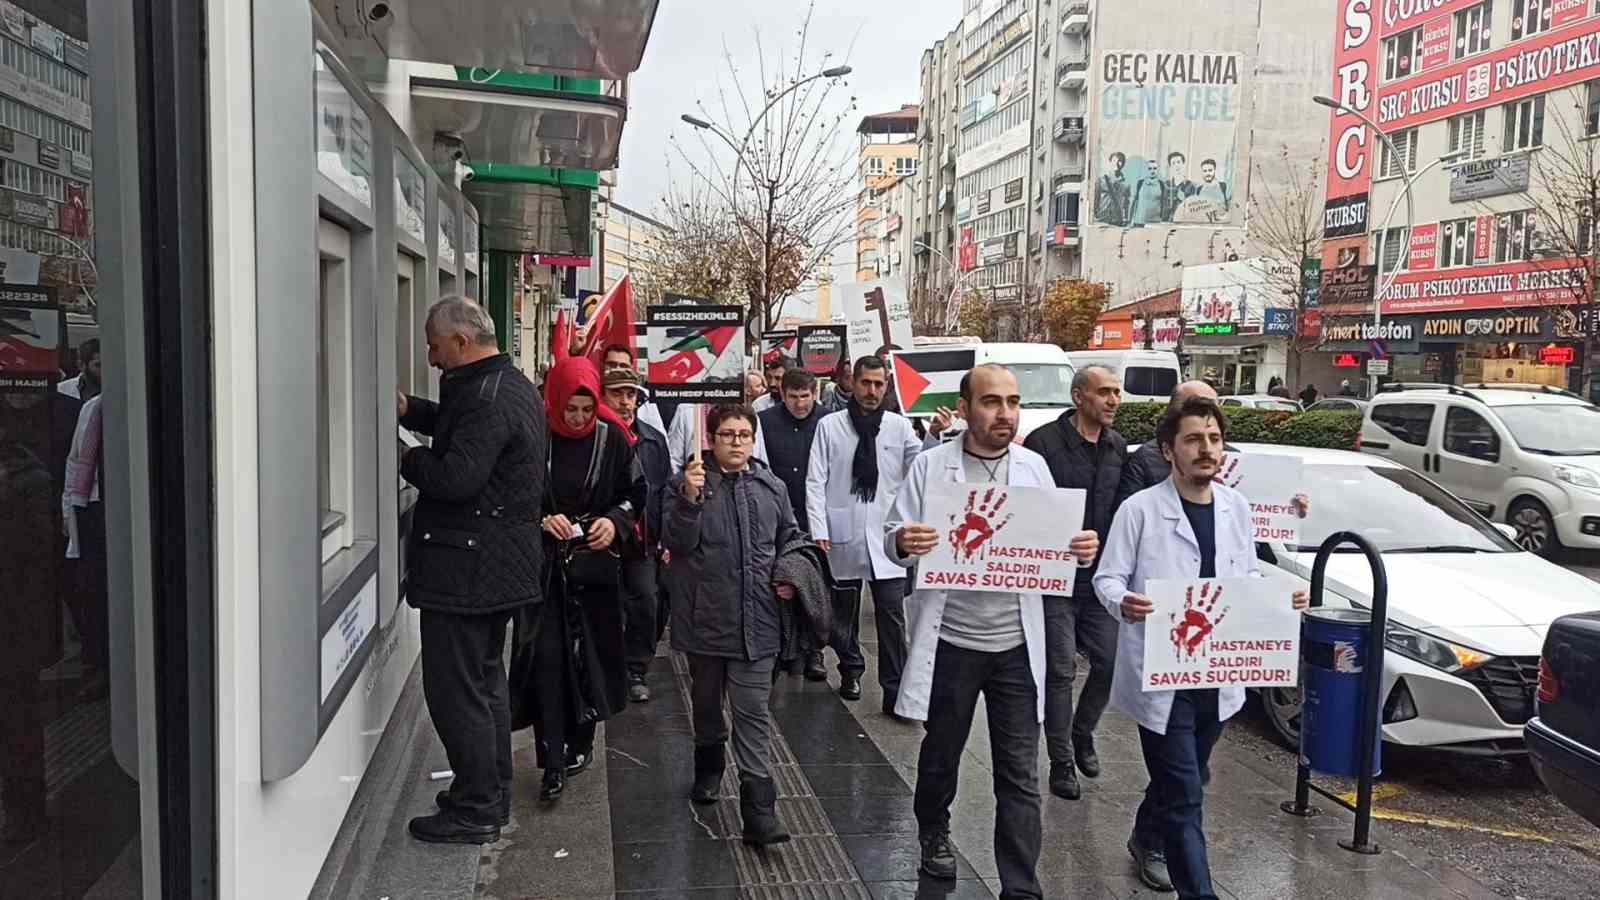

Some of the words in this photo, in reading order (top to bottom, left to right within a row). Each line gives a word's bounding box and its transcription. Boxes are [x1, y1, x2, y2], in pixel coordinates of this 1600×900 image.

[1423, 41, 1450, 58] KURSU
[1103, 53, 1148, 88] GEÇ
[1155, 54, 1238, 84] KALMA
[1102, 85, 1176, 126] GENÇ
[1184, 87, 1235, 121] GEL
[1379, 90, 1407, 123] SRC
[1409, 75, 1462, 115] KURSU
[1326, 201, 1366, 229] KURSU
[1382, 282, 1420, 301] ORUM
[1423, 271, 1513, 297] PSİKOTEKNİK
[653, 311, 738, 321] #SESSİZHEKİMLER
[1424, 319, 1462, 335] AYDIN
[1495, 314, 1540, 333] OPTİK
[1361, 321, 1412, 339] telefon
[1249, 503, 1295, 515] TANEYE
[1254, 528, 1294, 539] UDUR!
[989, 546, 1071, 562] HASTANEYE
[986, 561, 1040, 575] SALDIRI
[924, 571, 977, 587] SAVAŞ
[982, 574, 1067, 592] SUÇUDUR!
[1210, 640, 1292, 652] HASTANEYE
[1209, 656, 1262, 668] SALDIRI
[1150, 671, 1202, 686] SAVAŞ
[1206, 669, 1291, 684] SUÇUDUR!
